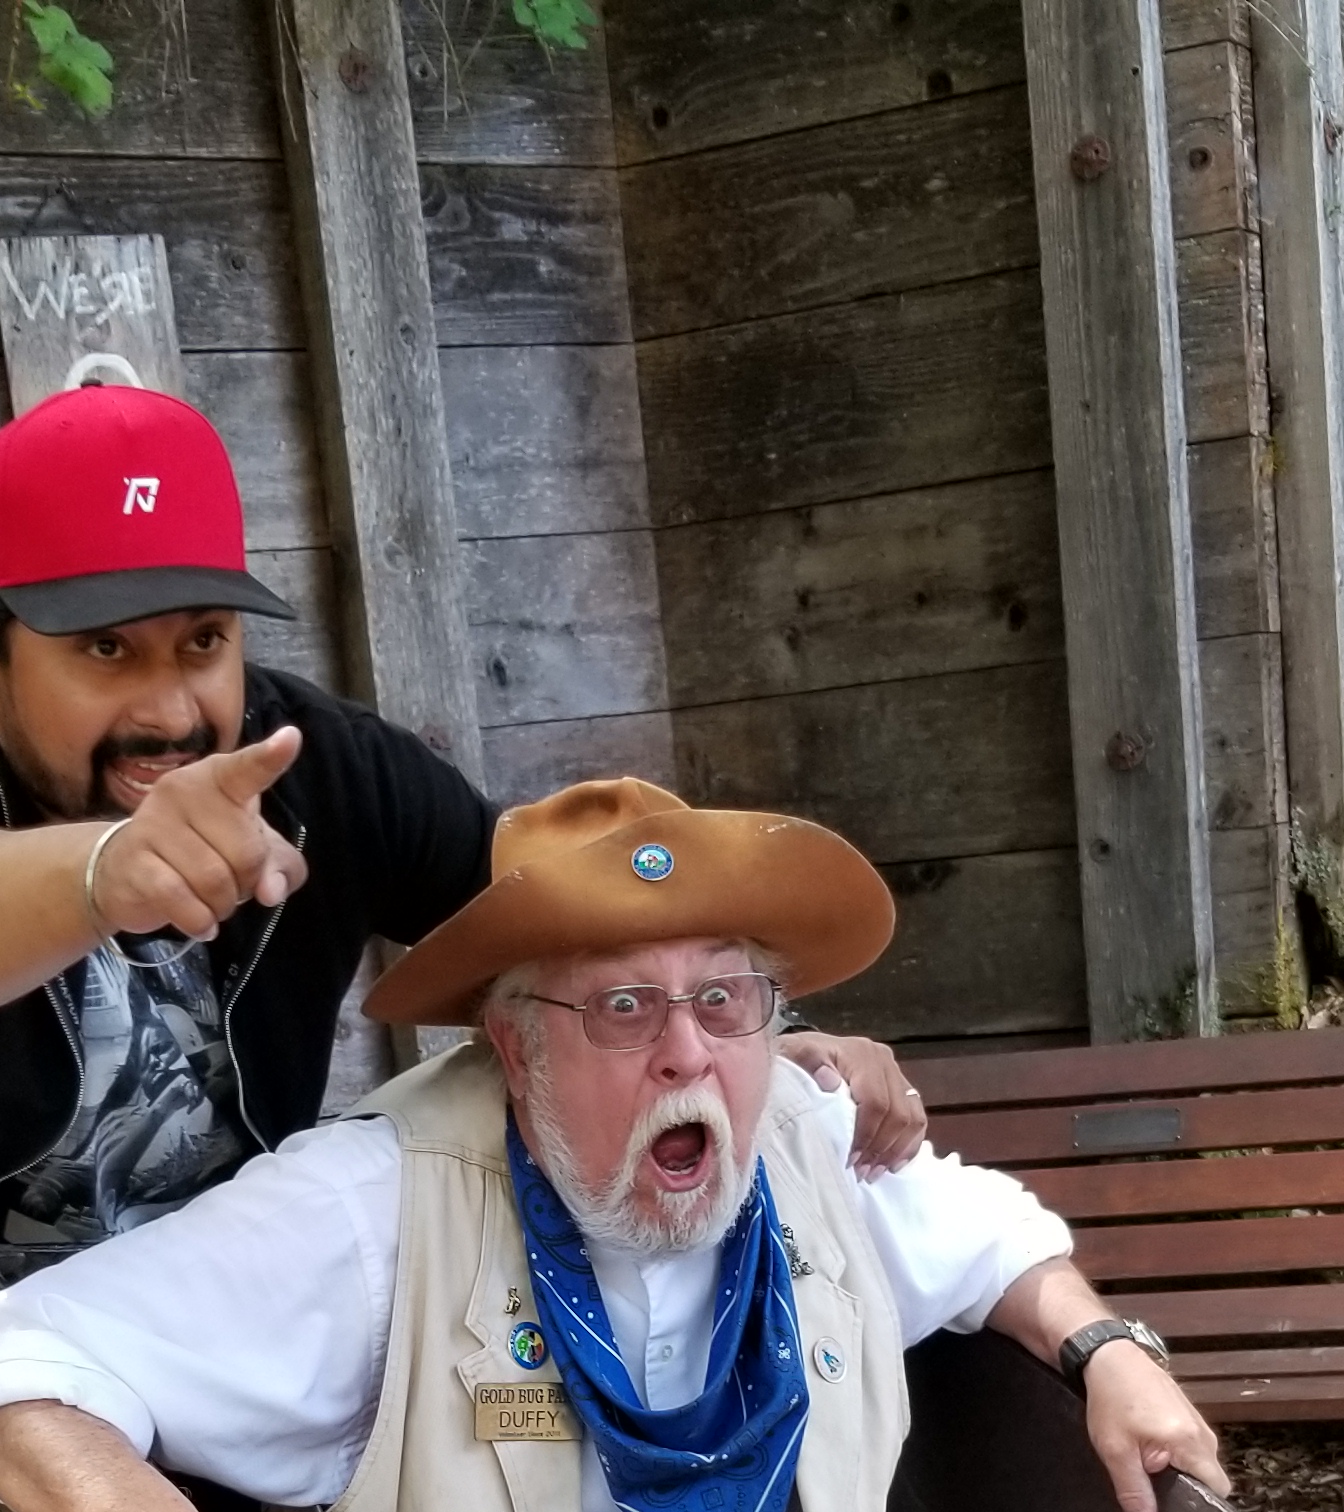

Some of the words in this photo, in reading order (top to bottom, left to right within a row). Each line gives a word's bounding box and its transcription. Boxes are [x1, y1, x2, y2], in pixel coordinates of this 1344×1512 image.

[480, 1388, 515, 1404] GOLD
[518, 1388, 544, 1404] BUG
[548, 1388, 565, 1403] PA
[499, 1410, 560, 1428] DUFFY
